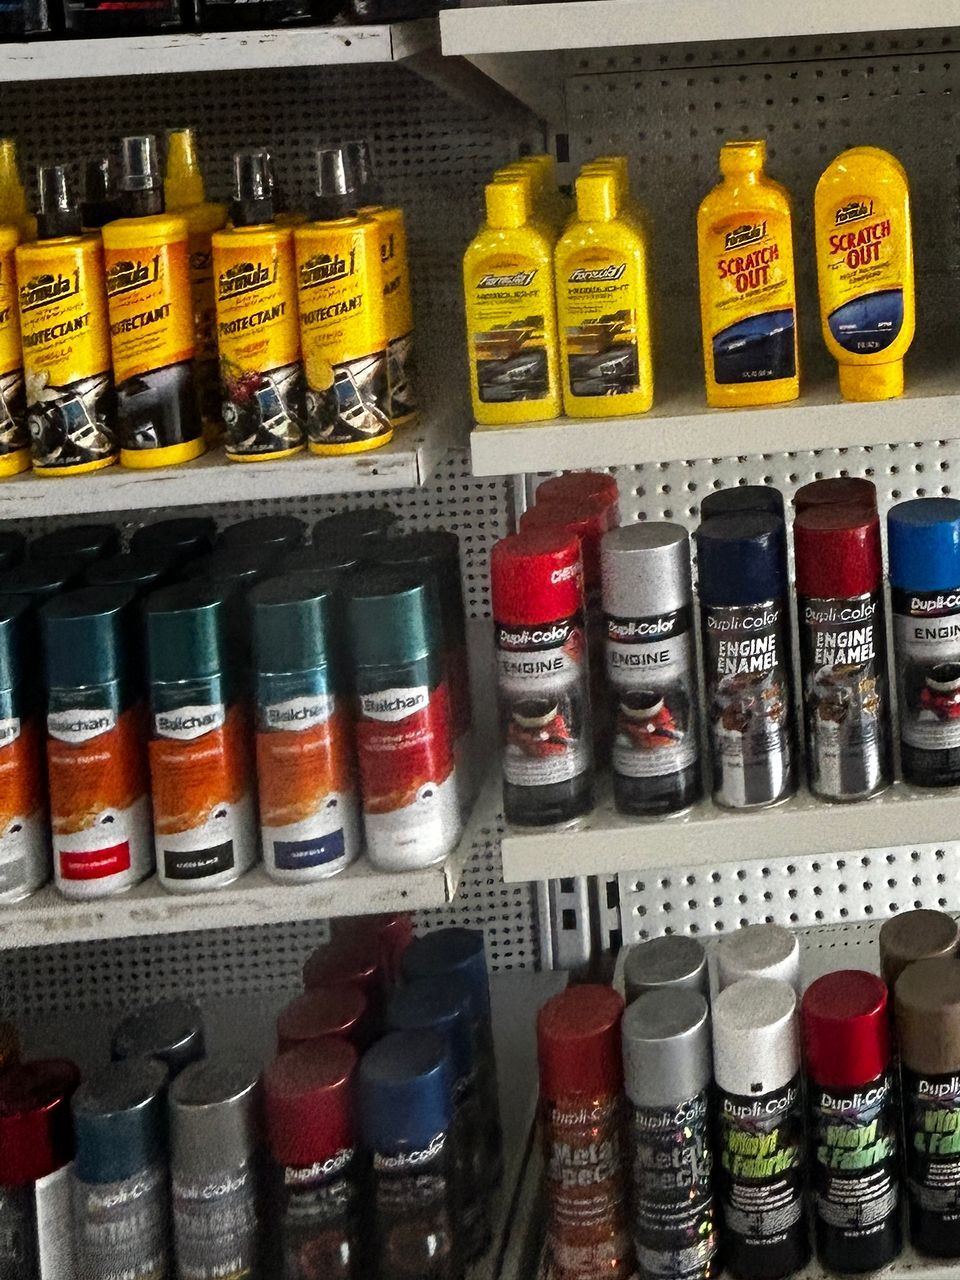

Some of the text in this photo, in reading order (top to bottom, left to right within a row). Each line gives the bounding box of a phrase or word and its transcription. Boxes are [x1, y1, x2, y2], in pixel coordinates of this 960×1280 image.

[828, 219, 892, 256] SCRATCH
[717, 243, 780, 280] SCRATCH
[846, 241, 882, 270] OUT
[735, 266, 770, 294] OUT
[718, 633, 777, 657] ENGINE
[817, 625, 874, 648] ENGINE
[717, 649, 779, 675] ENAMEL
[815, 642, 876, 665] ENAMEL
